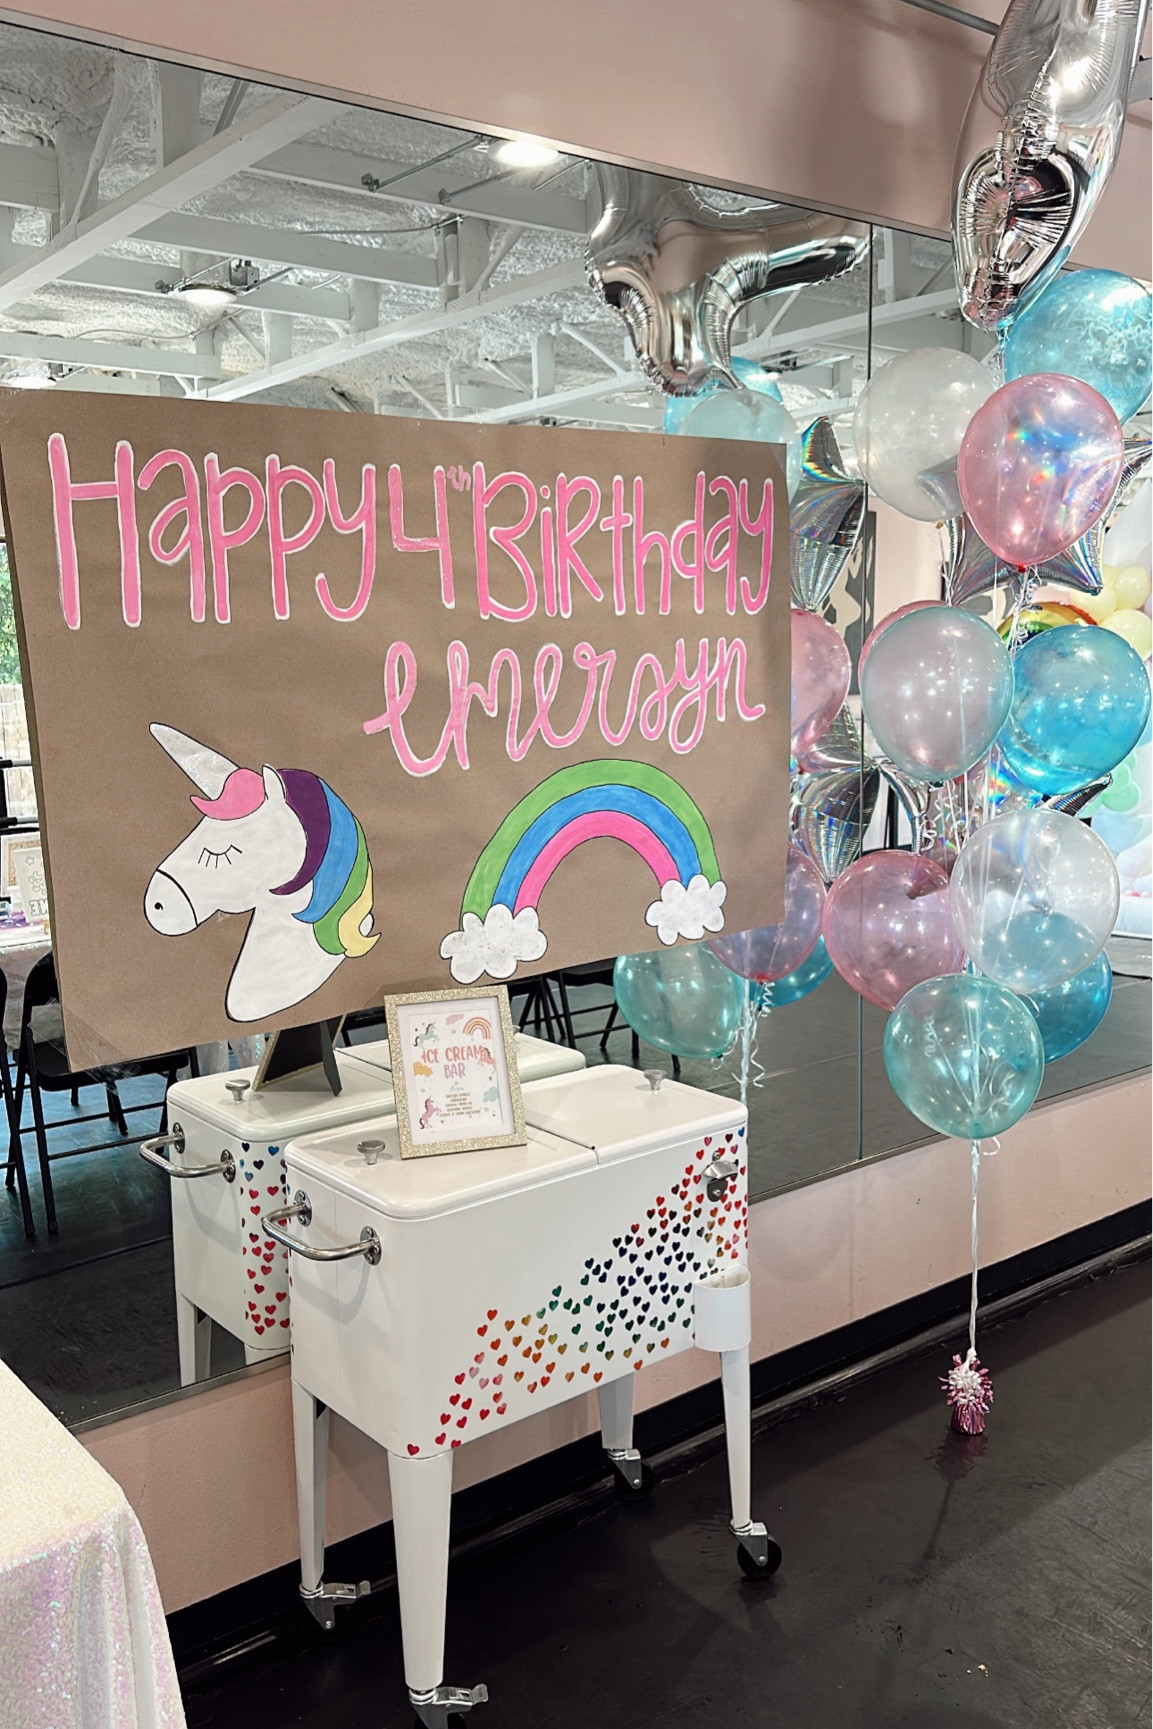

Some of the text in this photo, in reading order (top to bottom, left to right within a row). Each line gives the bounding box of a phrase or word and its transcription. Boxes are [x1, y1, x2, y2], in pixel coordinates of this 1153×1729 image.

[47, 432, 378, 629] Happy
[421, 1045, 483, 1064] ICE CREAM
[444, 1062, 467, 1079] BAR
